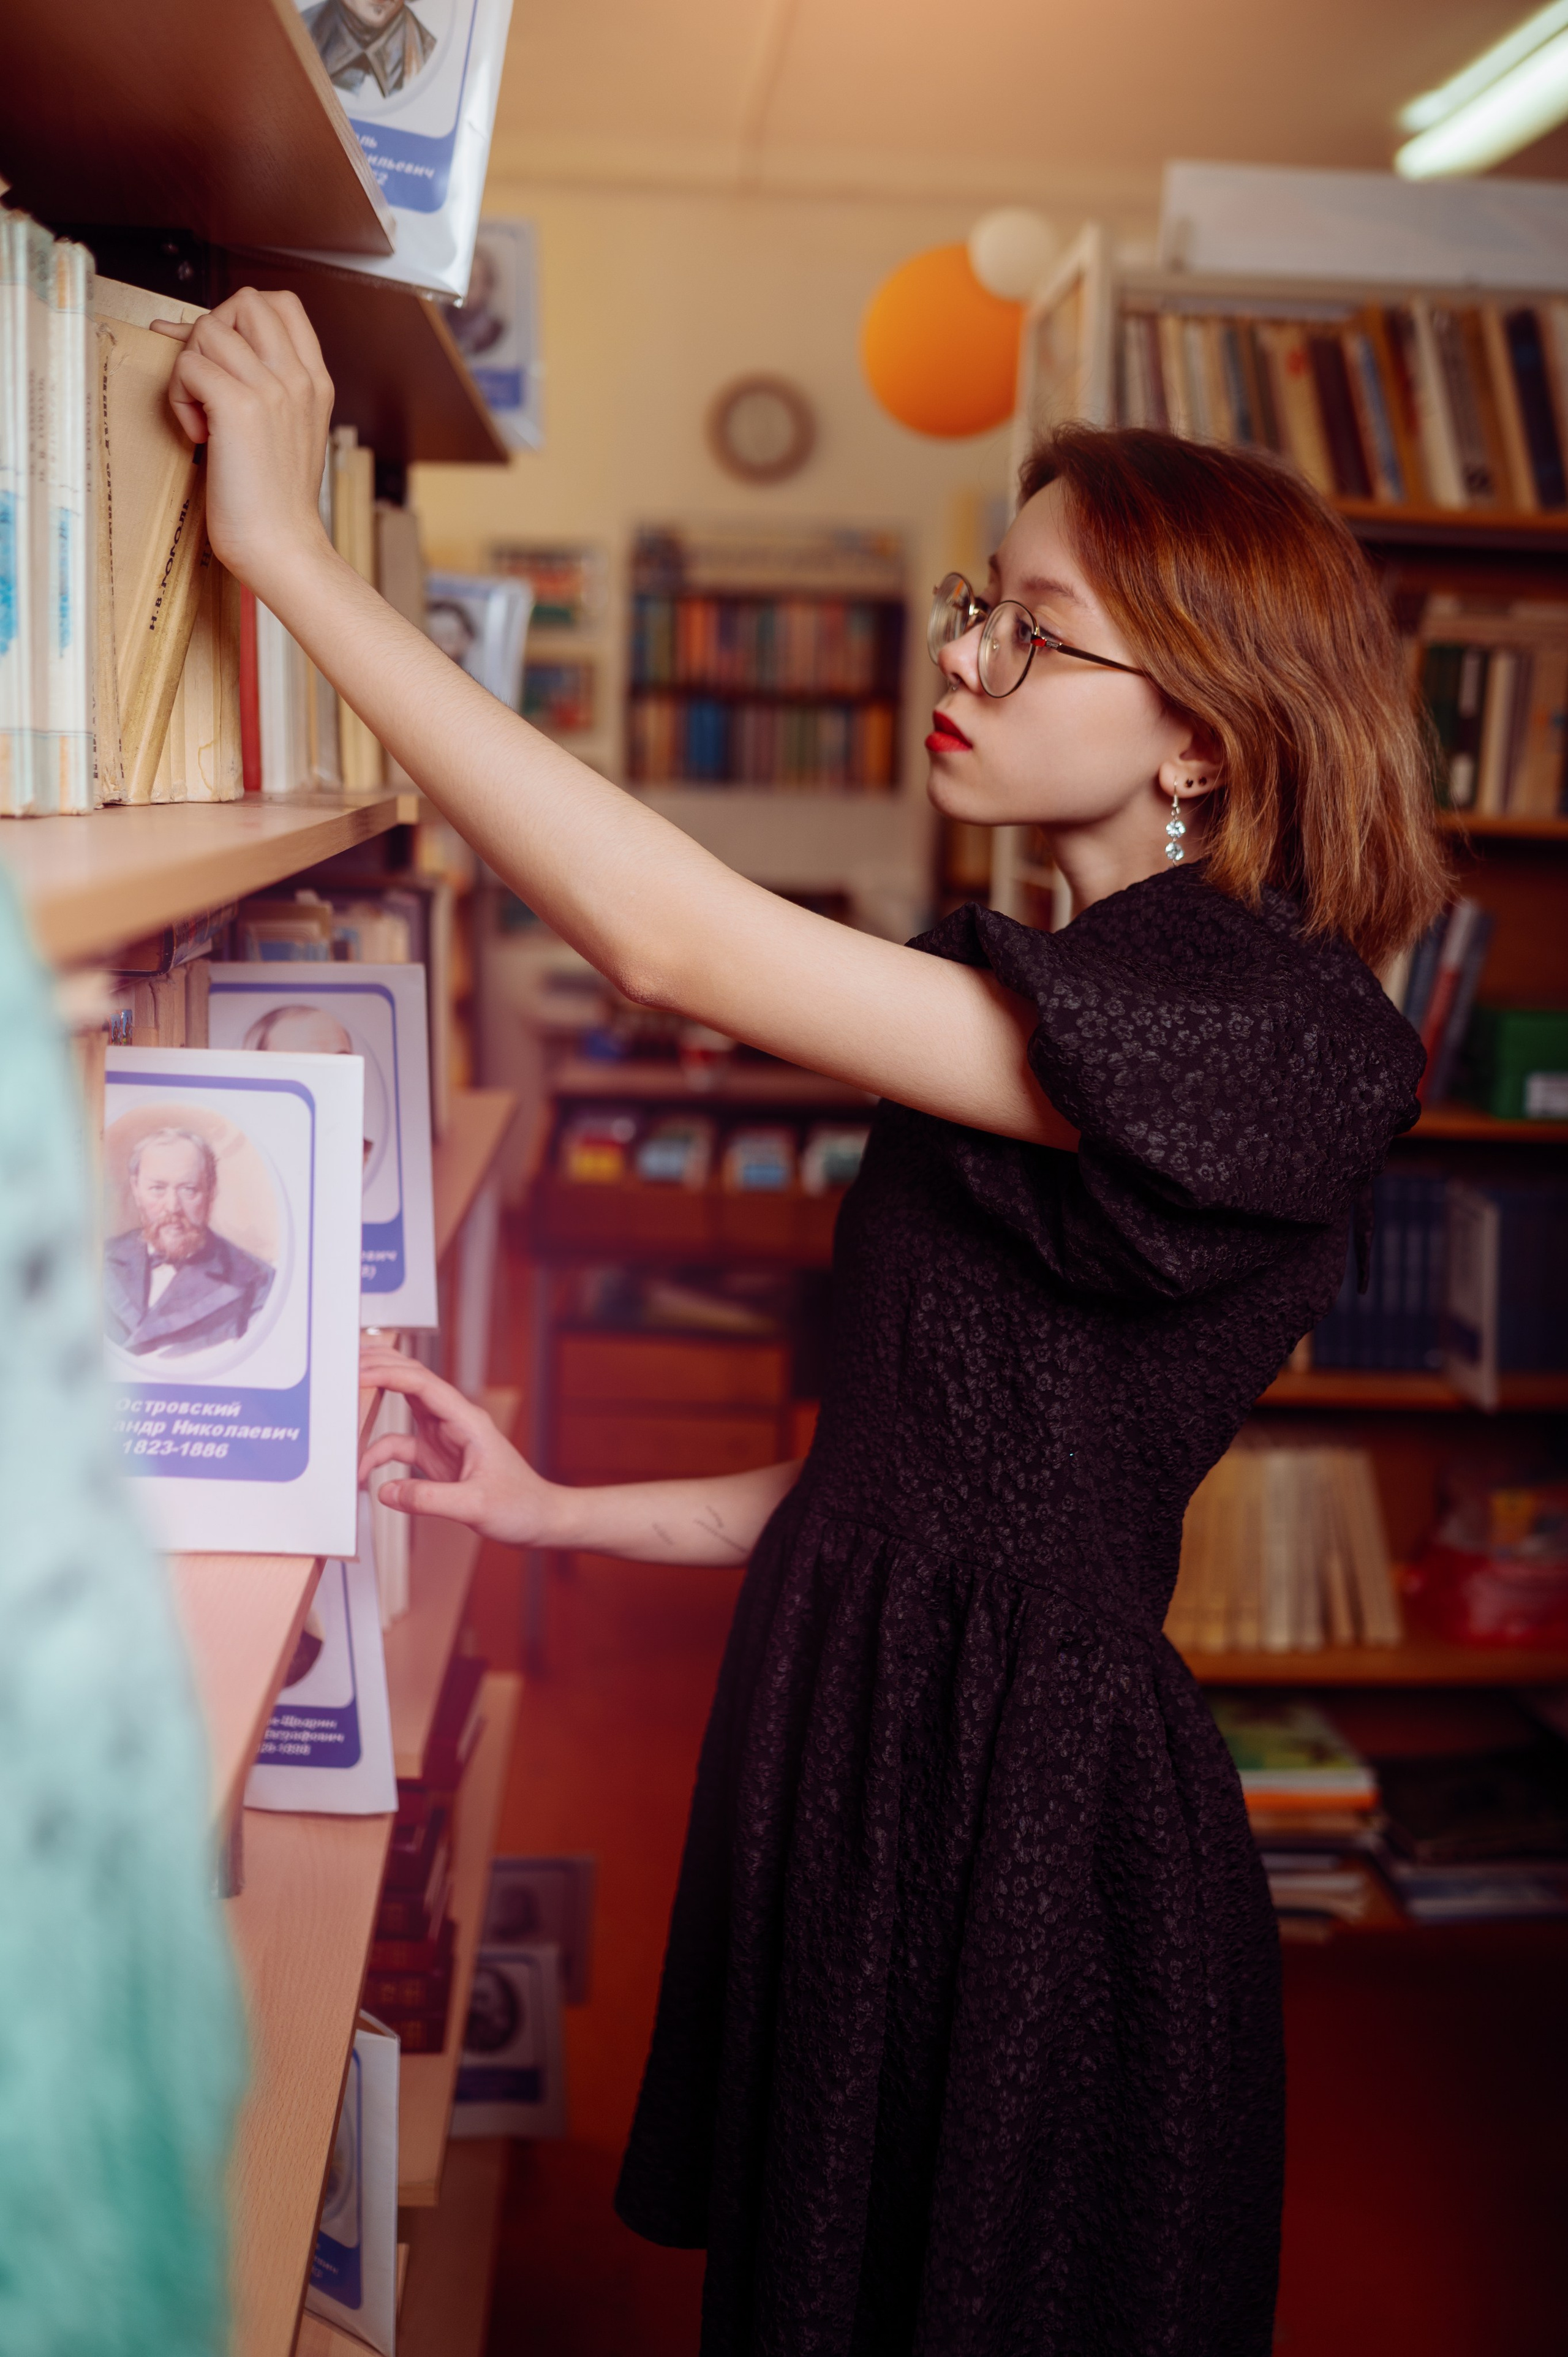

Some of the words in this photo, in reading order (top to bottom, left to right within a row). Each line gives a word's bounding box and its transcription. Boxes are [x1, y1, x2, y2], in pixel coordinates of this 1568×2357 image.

[367, 154, 435, 179] ильевич
[115, 1398, 242, 1417] Островский
[113, 1419, 166, 1436] андр
[171, 1419, 300, 1441] Николаевич
[123, 1439, 229, 1458] 1823-1886
